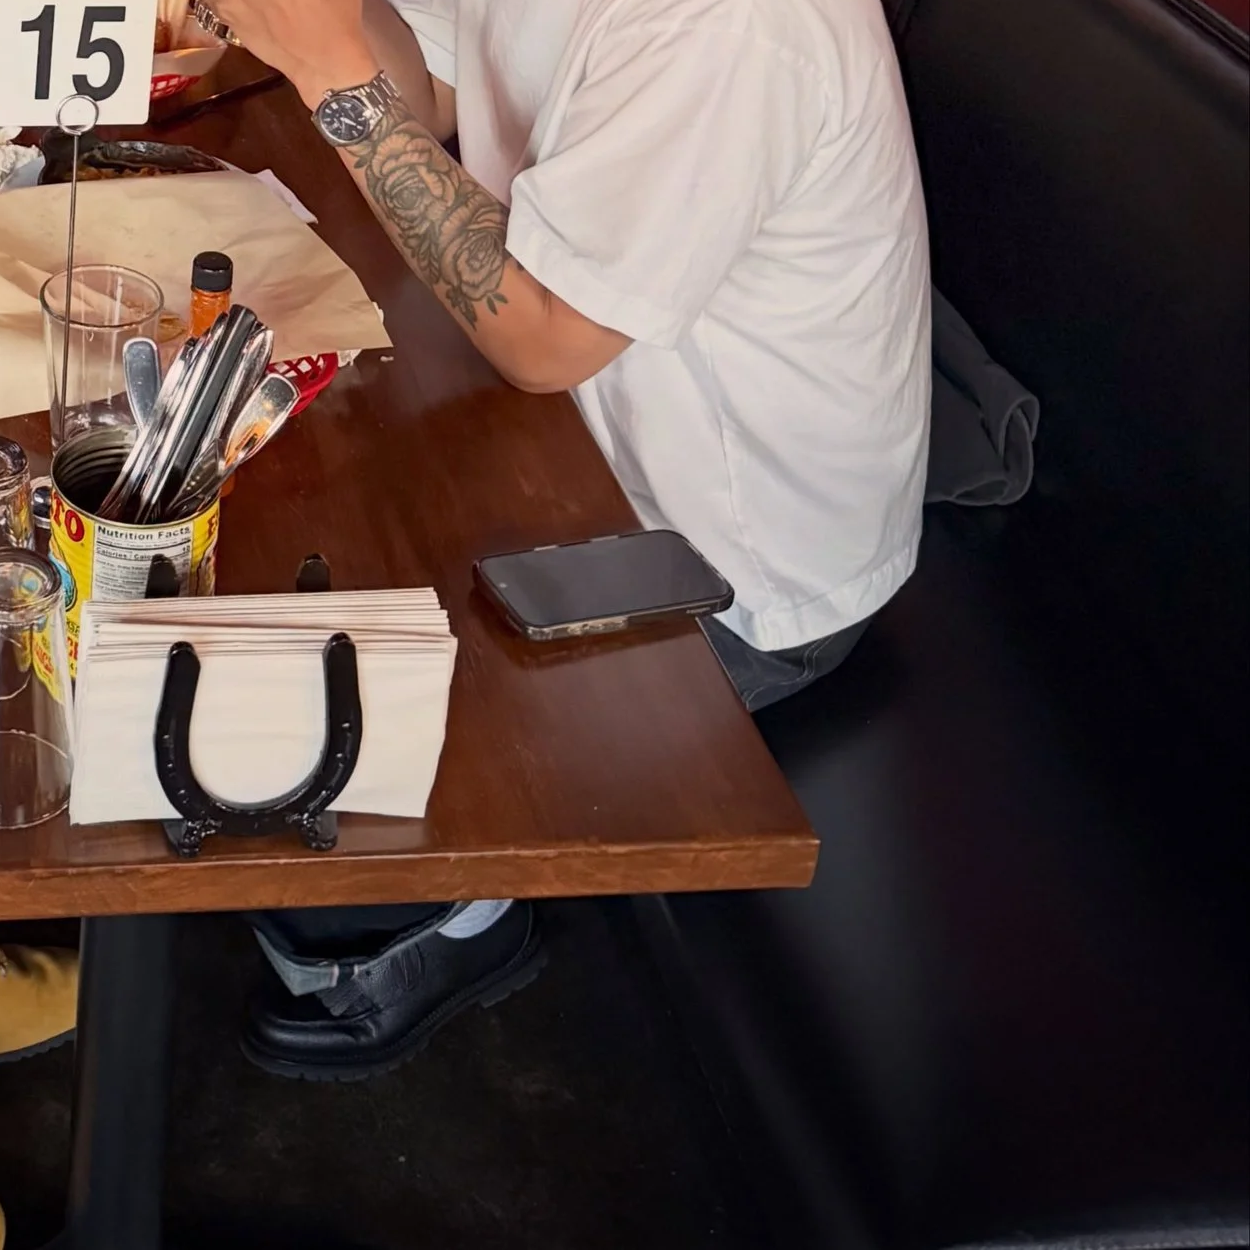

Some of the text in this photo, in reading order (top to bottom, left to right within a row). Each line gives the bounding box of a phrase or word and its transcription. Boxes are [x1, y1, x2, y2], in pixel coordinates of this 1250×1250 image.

[21, 4, 126, 102] 15
[97, 525, 190, 540] Nutrition Facts
